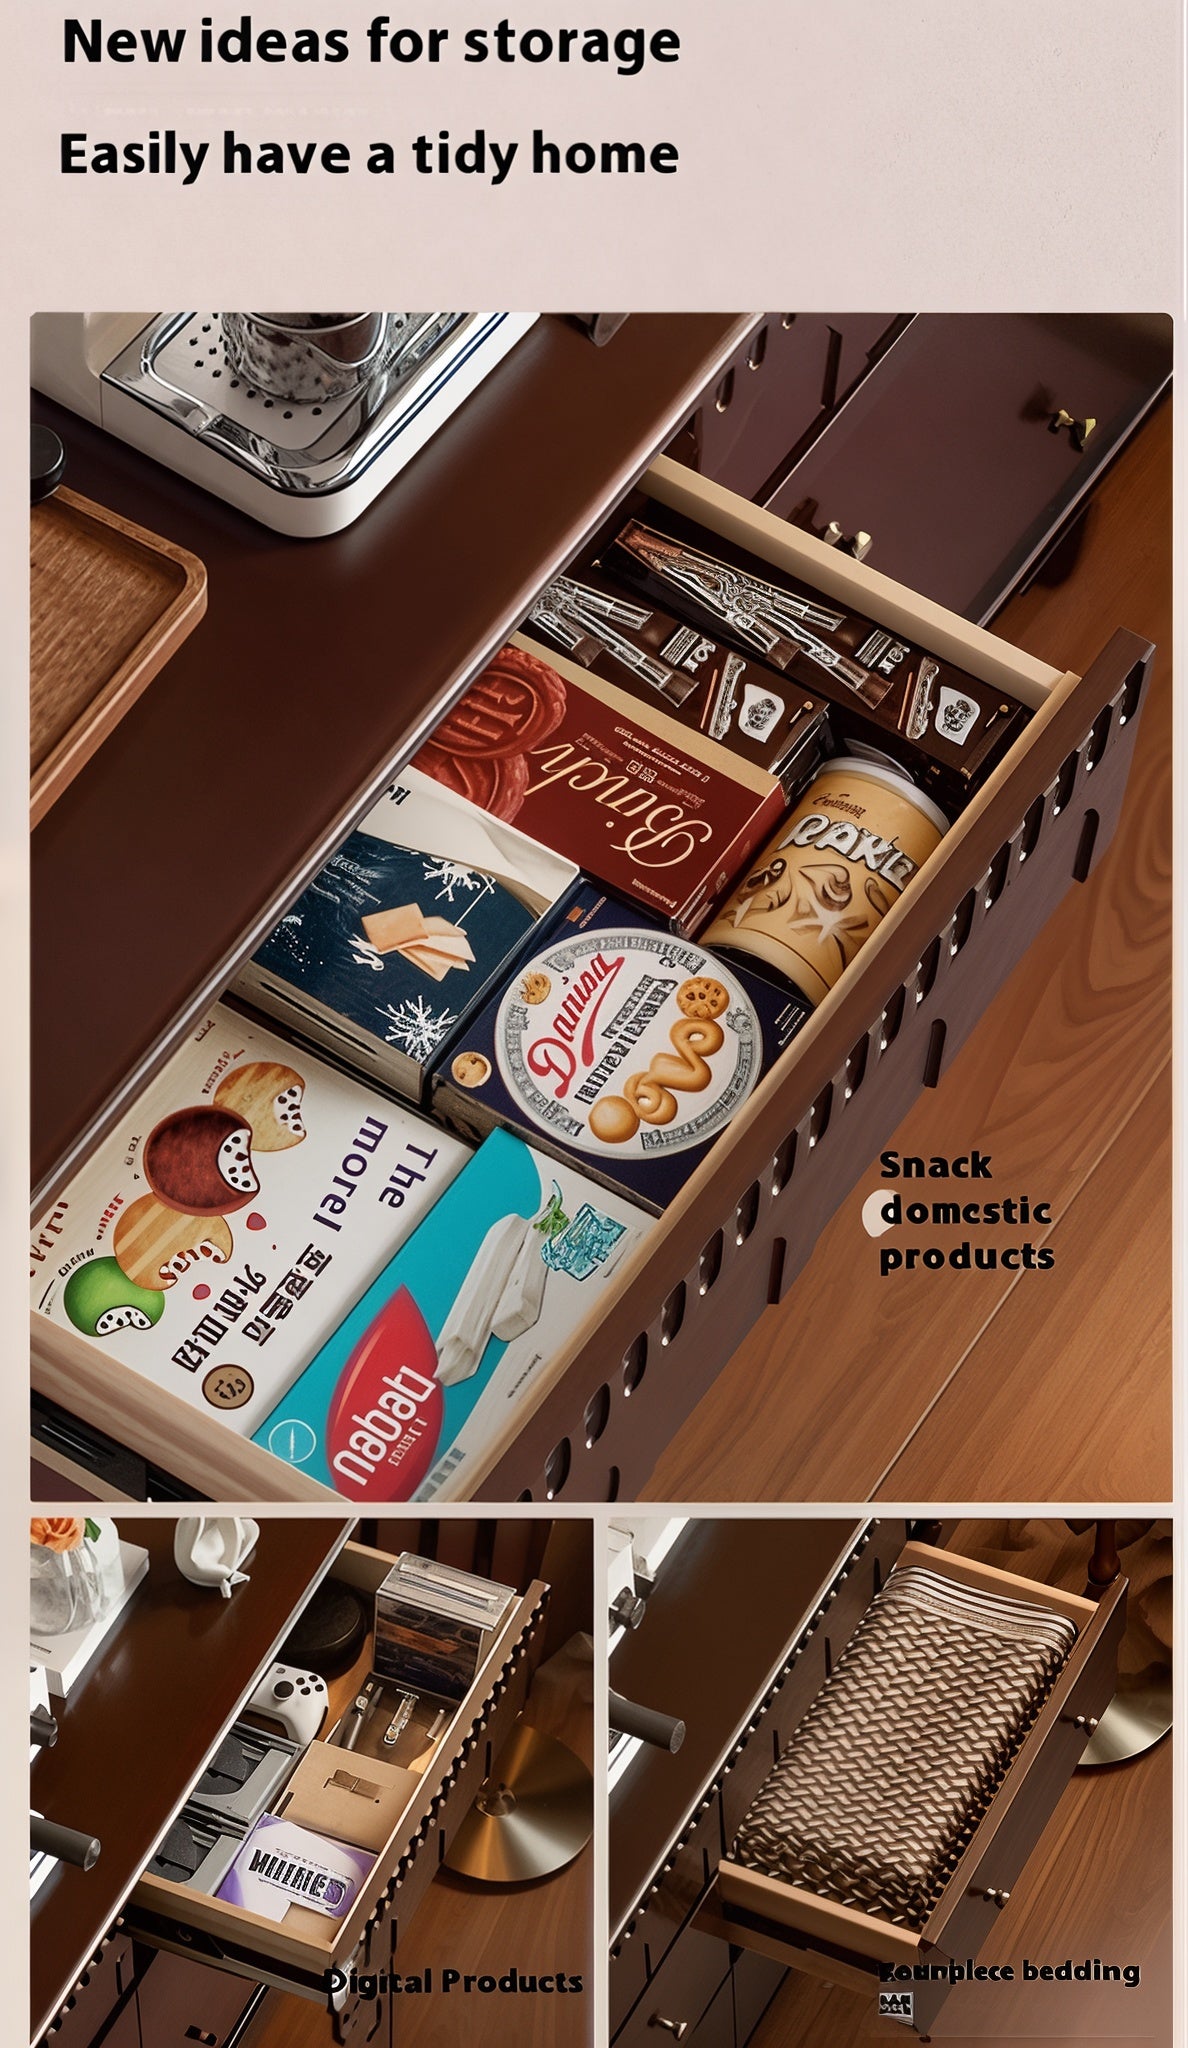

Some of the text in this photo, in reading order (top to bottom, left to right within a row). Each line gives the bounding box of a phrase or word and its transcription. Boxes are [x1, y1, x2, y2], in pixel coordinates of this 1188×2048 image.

[523, 743, 713, 868] Binch
[527, 952, 626, 1099] Danisa
[378, 1142, 439, 1210] The
